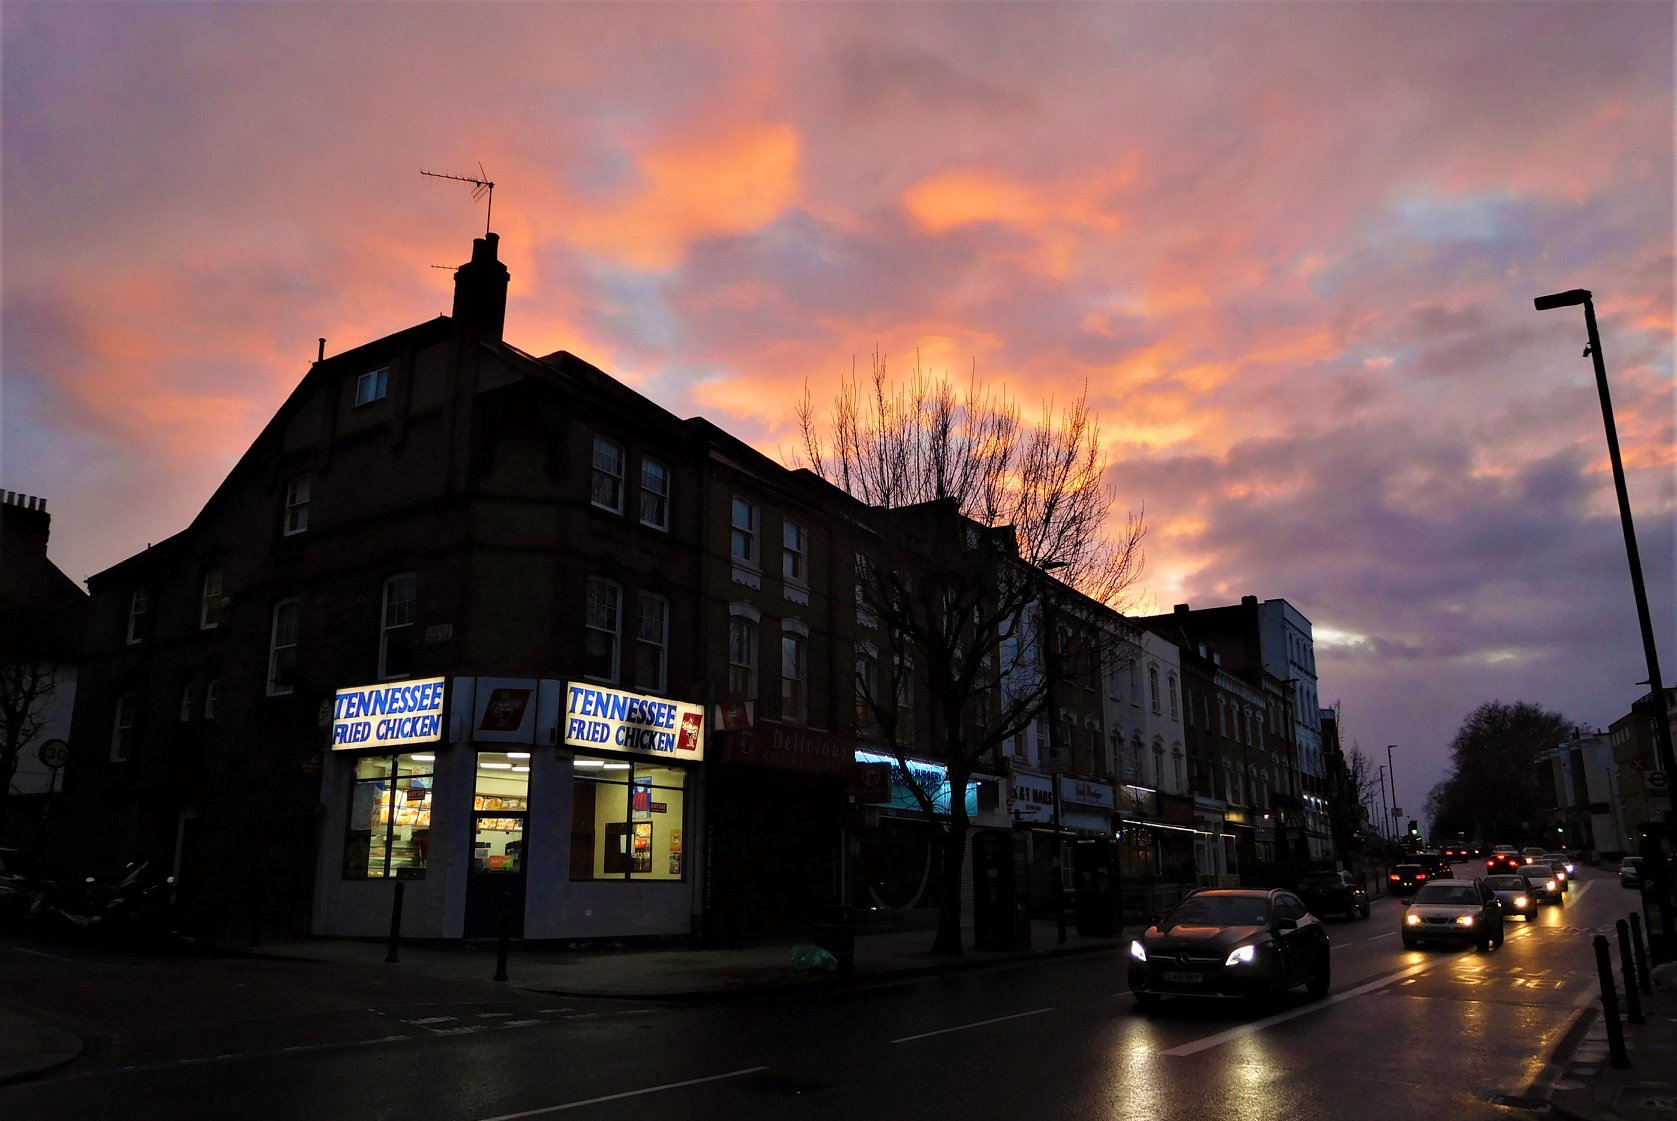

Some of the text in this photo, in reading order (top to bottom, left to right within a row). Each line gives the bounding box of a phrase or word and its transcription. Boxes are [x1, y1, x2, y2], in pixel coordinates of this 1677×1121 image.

[335, 682, 444, 719] TENNESSEE
[568, 686, 677, 729] TENNESSEE
[332, 714, 442, 745] FRIED CHICKEN
[566, 718, 611, 743] FRIED
[615, 725, 675, 752] CHICKEN
[772, 729, 847, 759] Delicious
[47, 747, 66, 761] 30
